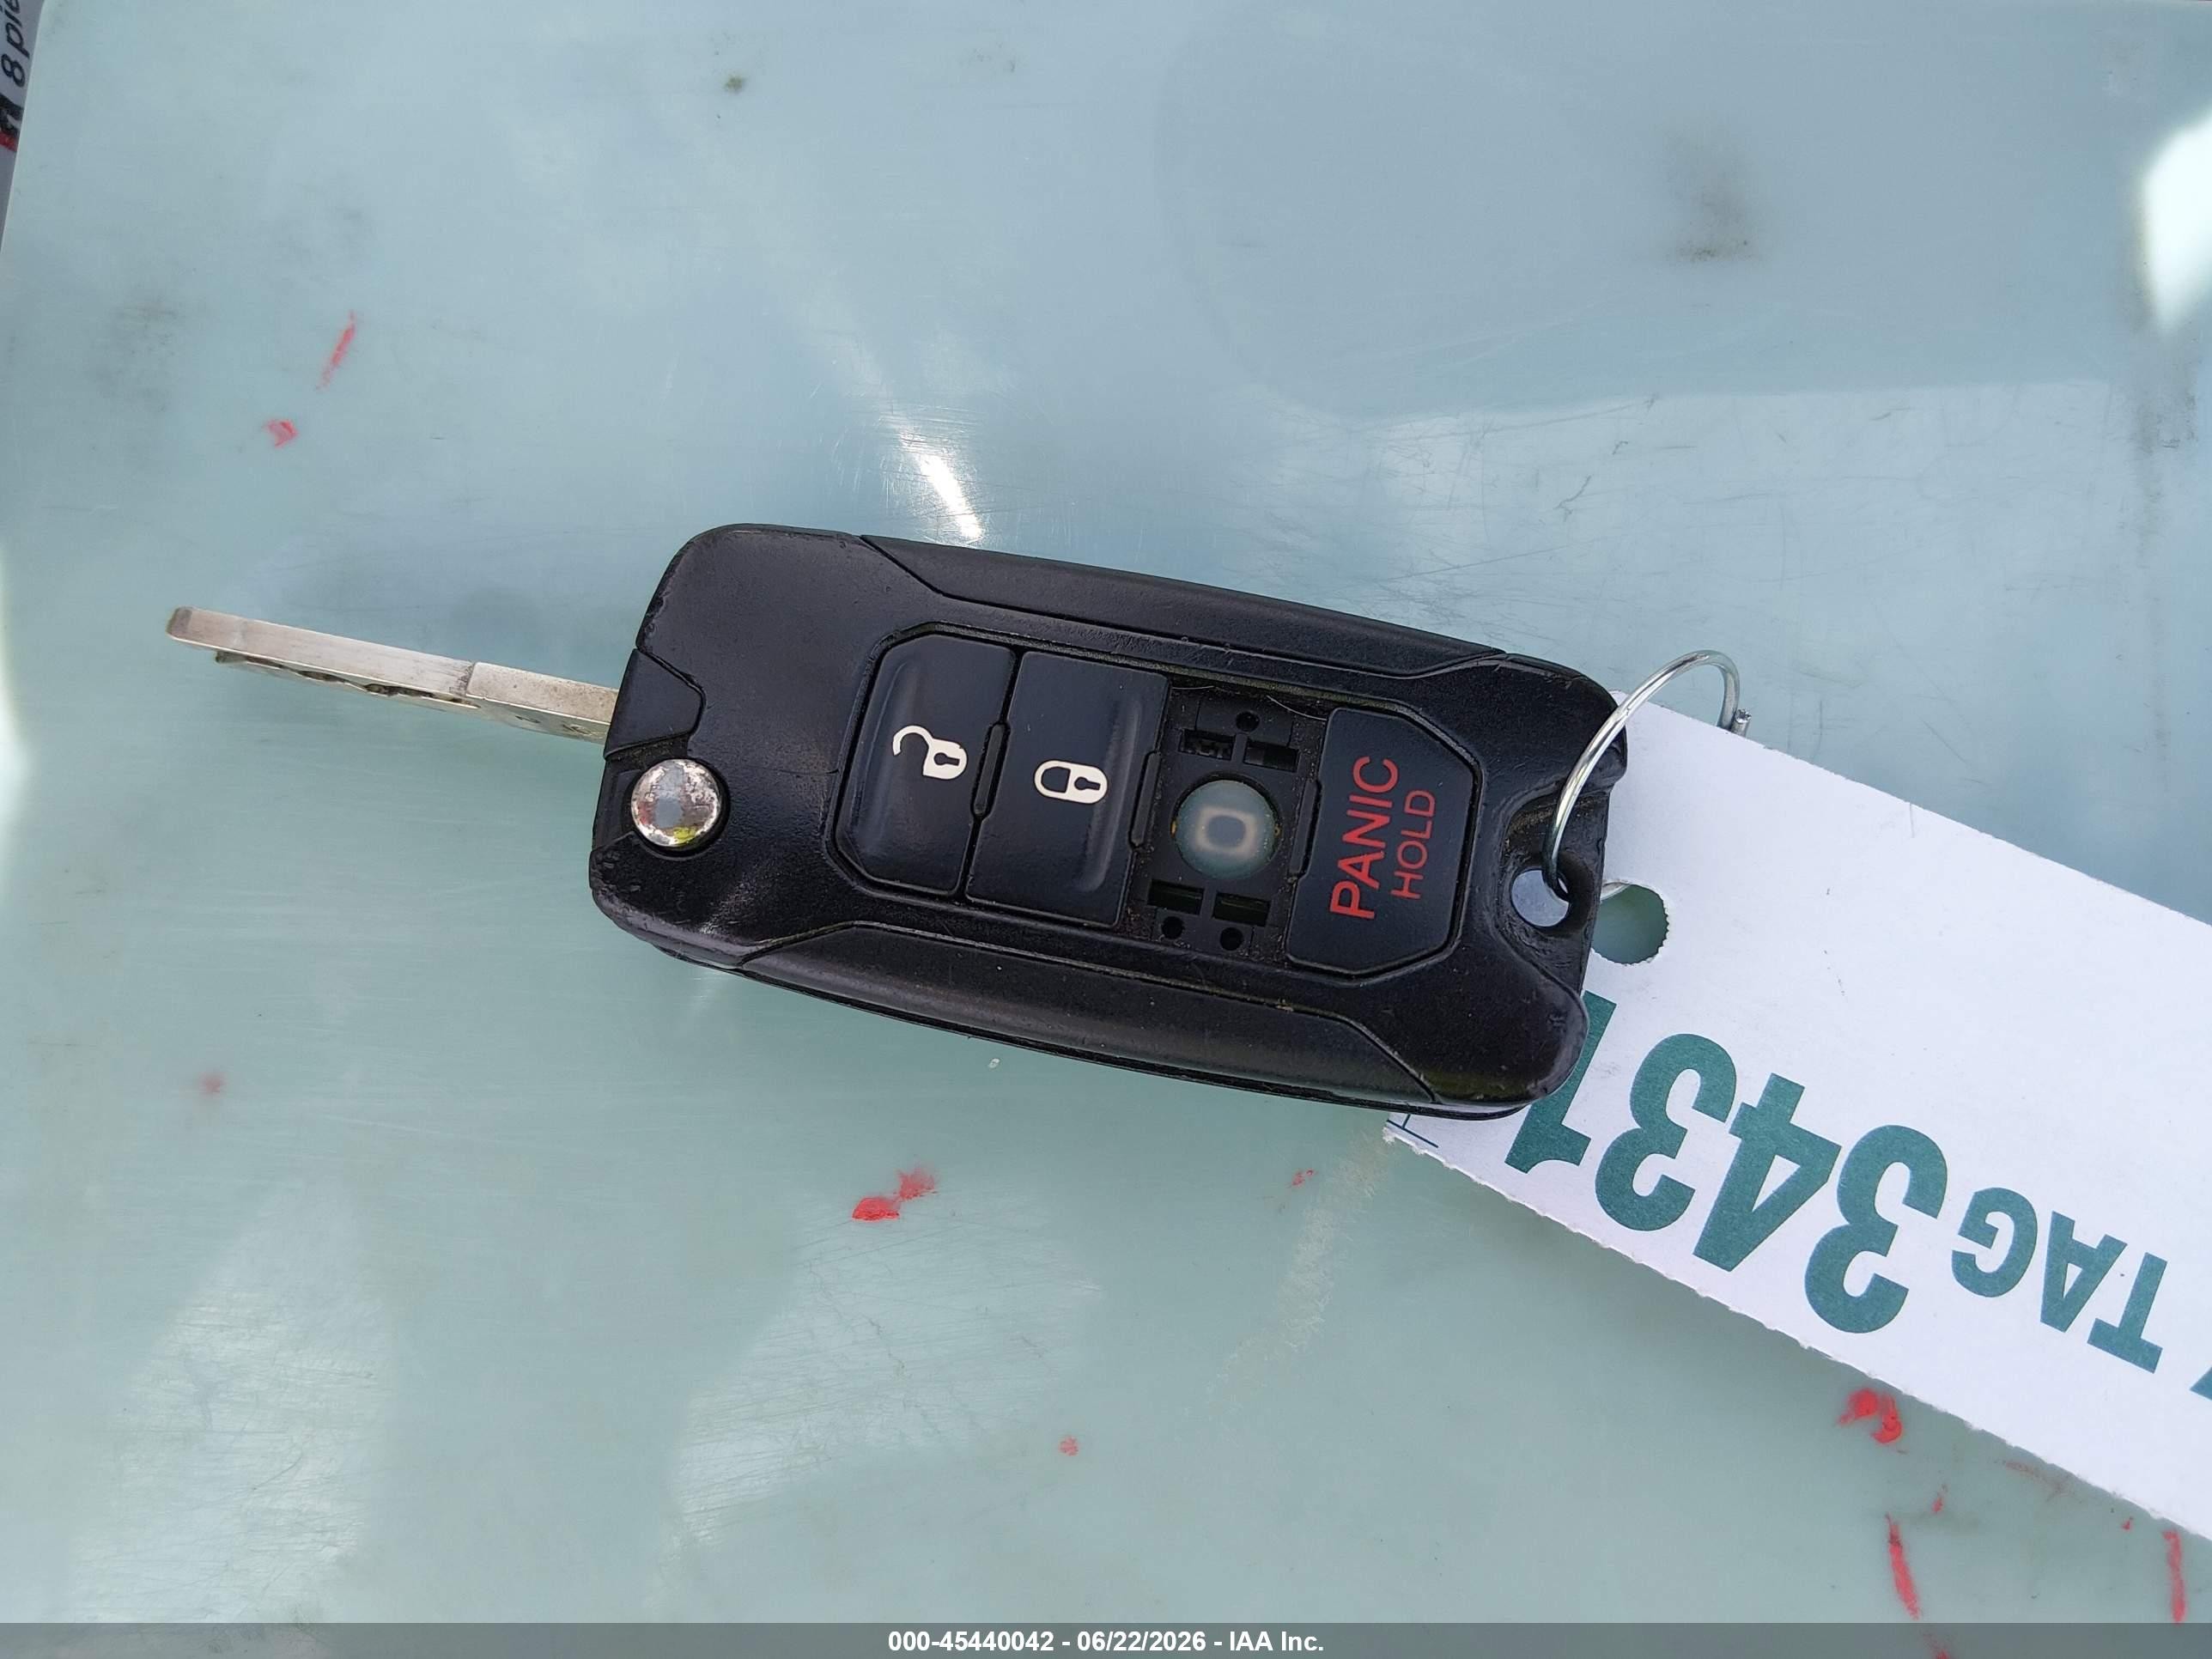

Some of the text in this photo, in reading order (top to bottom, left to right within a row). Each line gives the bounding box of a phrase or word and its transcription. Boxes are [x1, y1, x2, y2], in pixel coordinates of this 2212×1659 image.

[1, 53, 26, 88] 8
[1329, 757, 1398, 920] PANIC
[1390, 790, 1436, 899] HOLD
[1504, 990, 2168, 1374] TAG 3431
